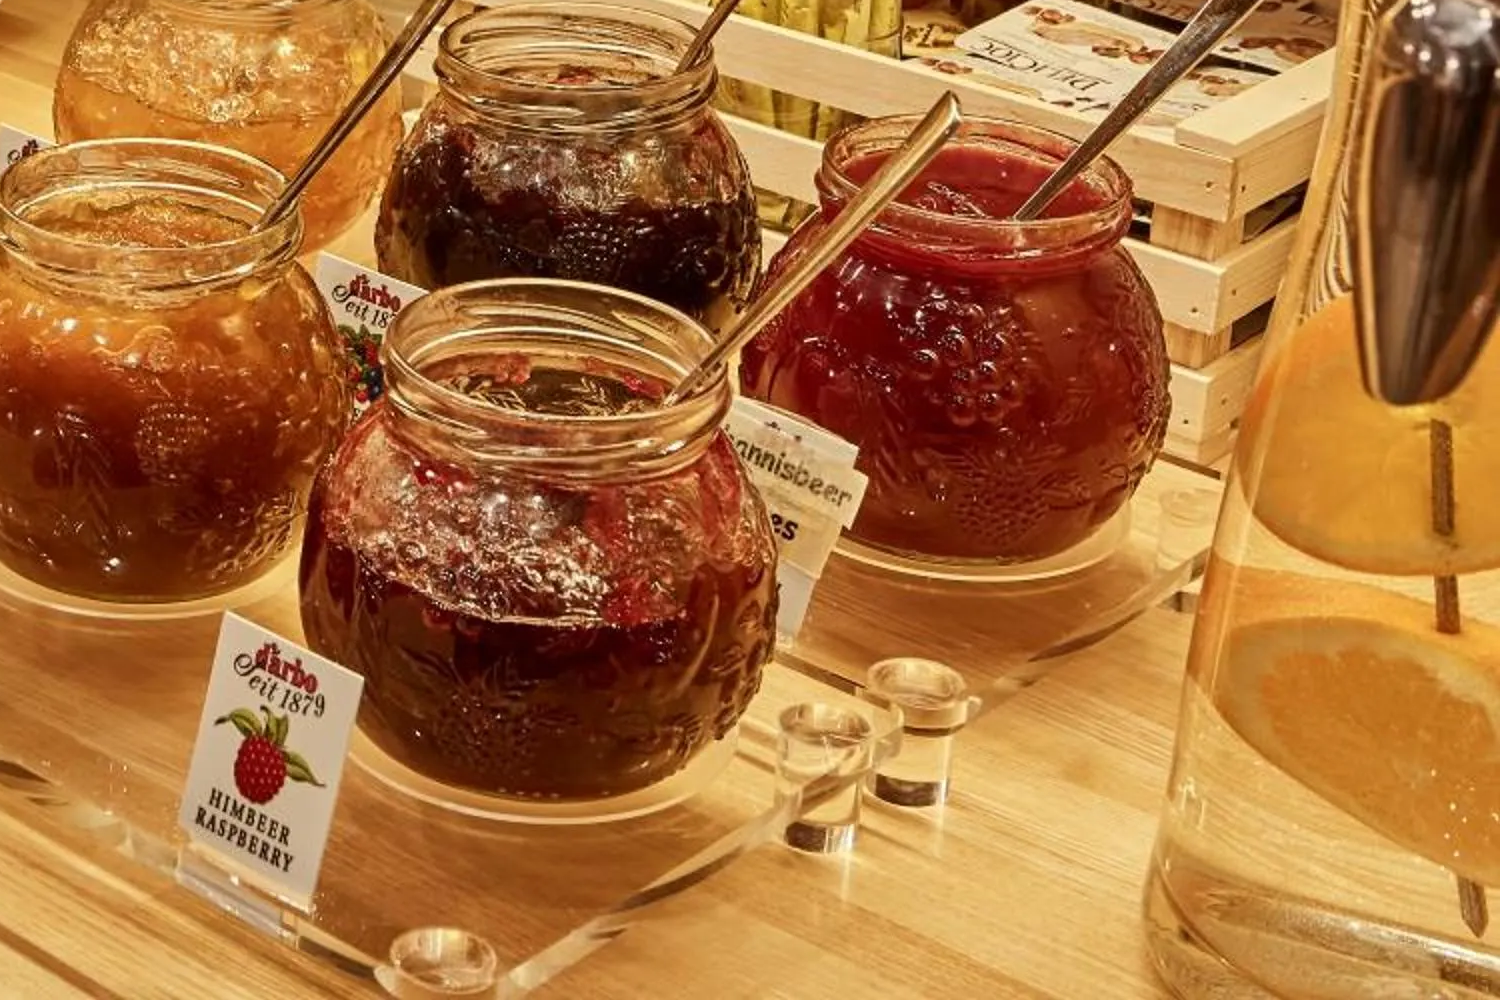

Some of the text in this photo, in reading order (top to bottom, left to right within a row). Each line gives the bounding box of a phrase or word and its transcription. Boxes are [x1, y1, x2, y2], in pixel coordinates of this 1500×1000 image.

[331, 284, 370, 321] Seit
[233, 652, 327, 720] Seit 1879
[194, 805, 295, 873] RASPBERRY
[208, 787, 292, 846] HIMBEER
